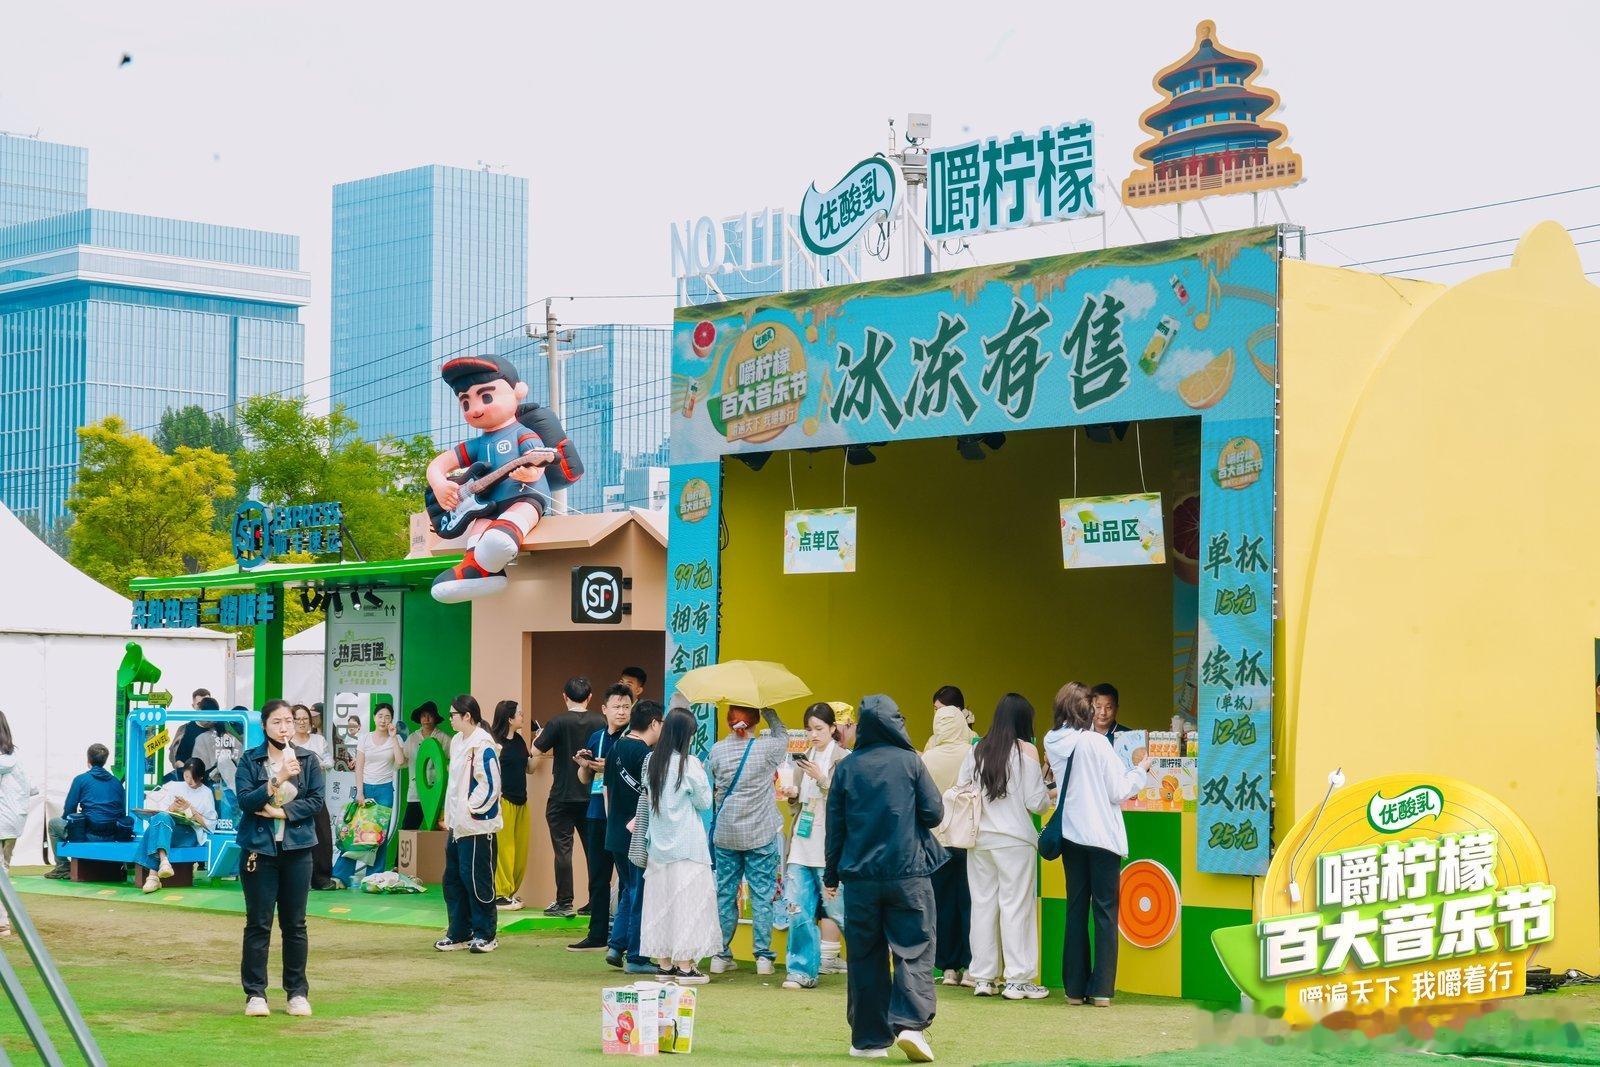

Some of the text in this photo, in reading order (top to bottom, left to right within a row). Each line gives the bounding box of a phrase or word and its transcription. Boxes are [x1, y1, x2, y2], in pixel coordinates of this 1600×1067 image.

[930, 123, 1094, 235] 嚼柠檬
[815, 168, 886, 241] 优酸乳
[738, 347, 791, 386] 嚼柠檬
[829, 294, 1129, 430] 冰冻有售
[721, 370, 807, 420] 百大音乐节
[274, 502, 342, 530] EXPRESS
[1084, 519, 1140, 543] 出品区
[799, 531, 839, 551] 点单区
[1204, 532, 1268, 579] 单杯
[674, 559, 712, 590] 99元
[1214, 584, 1257, 615] 15元
[671, 602, 710, 634] 拥有
[338, 641, 387, 664] 热爱传递
[671, 645, 709, 674] 全国
[1201, 645, 1268, 690] 续杯
[146, 734, 169, 754] TRAVEL
[214, 737, 235, 748] SIGN
[1212, 714, 1256, 746] 12元
[1200, 772, 1268, 812] 双杯
[1378, 791, 1435, 827] 优酸乳
[1208, 819, 1258, 851] 25元
[1321, 833, 1497, 907] 嚼柠檬
[1260, 886, 1556, 978] 百大音乐节
[1299, 961, 1514, 1006] 嚼遍天下 我嚼着行
